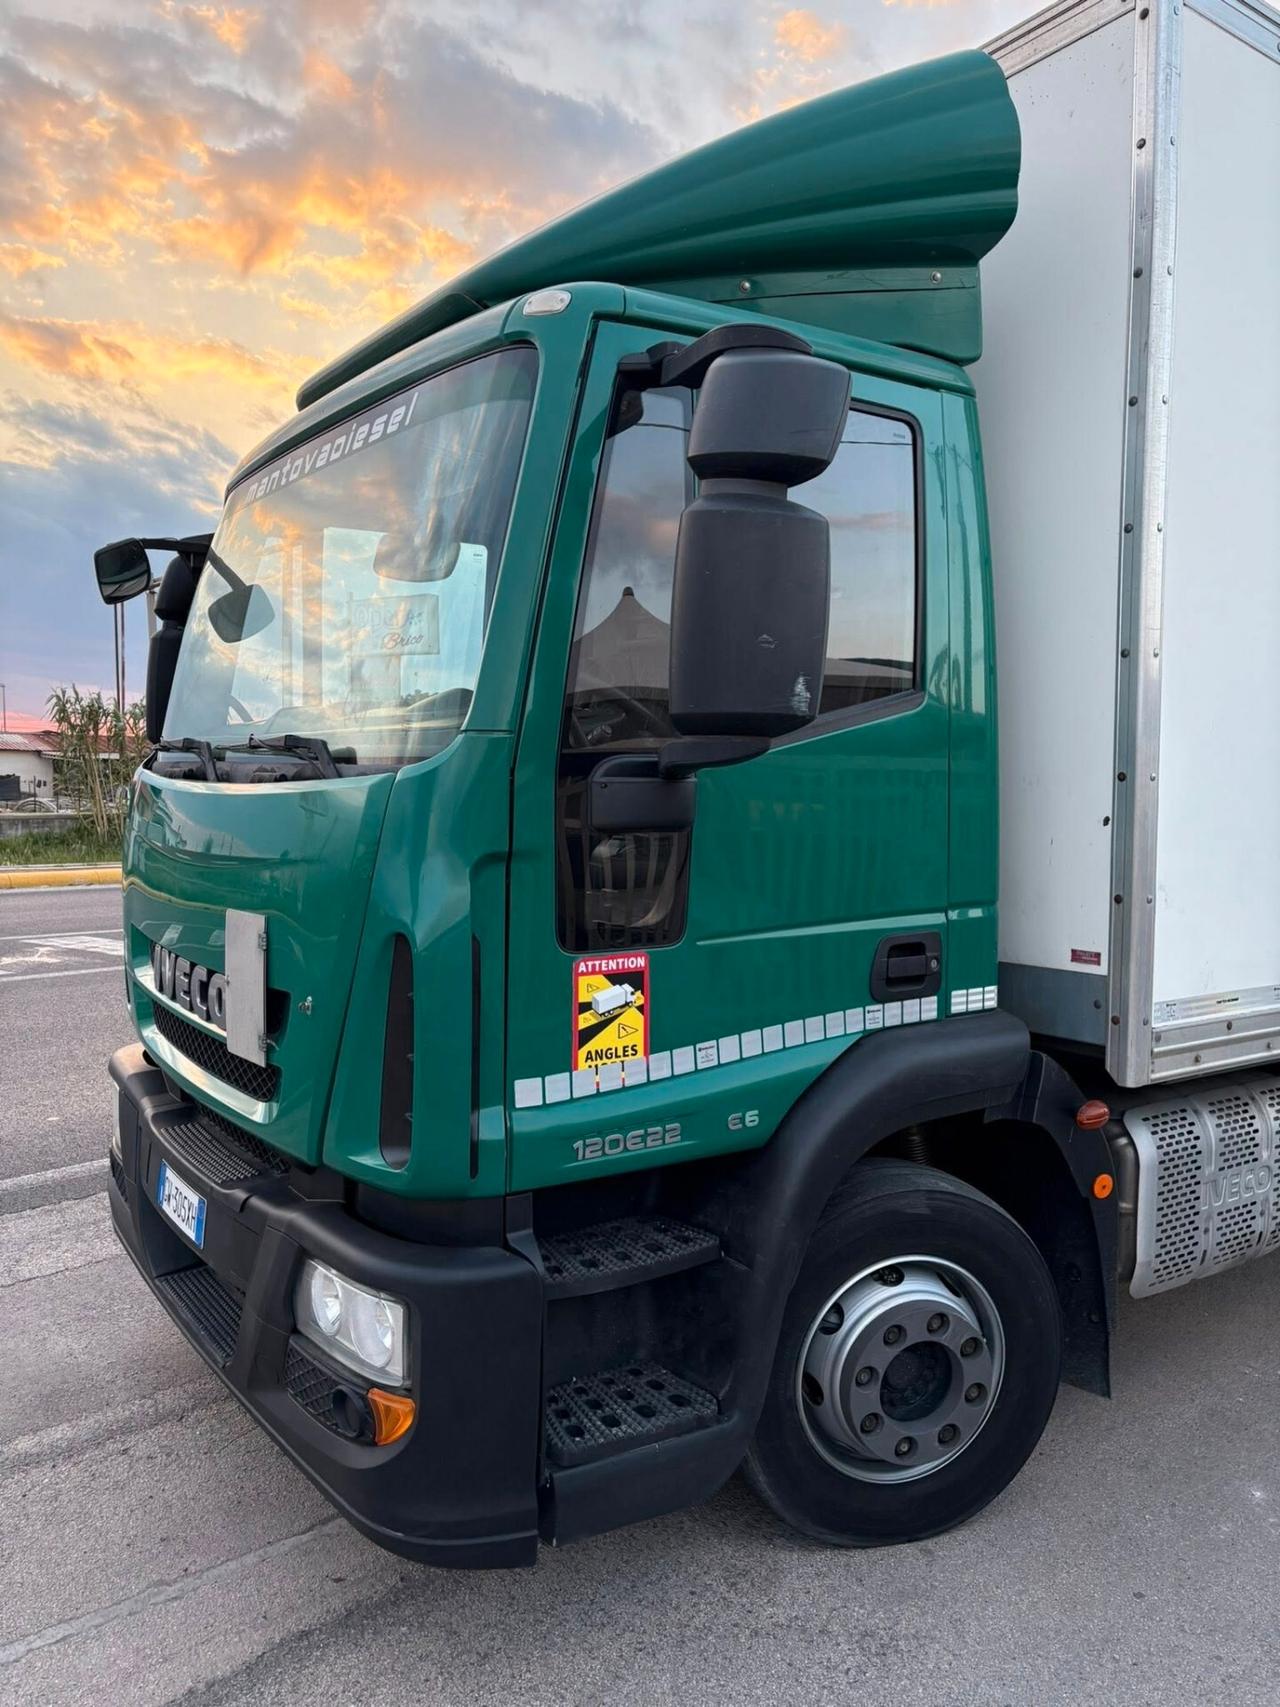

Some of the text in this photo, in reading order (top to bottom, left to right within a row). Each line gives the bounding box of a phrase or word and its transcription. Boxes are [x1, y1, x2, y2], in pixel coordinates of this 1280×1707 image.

[578, 956, 645, 973] ATTENTION
[152, 943, 227, 1030] IVECO
[585, 1044, 638, 1063] ANGLES
[572, 1123, 682, 1161] 120E22
[1201, 1165, 1272, 1210] IVECO
